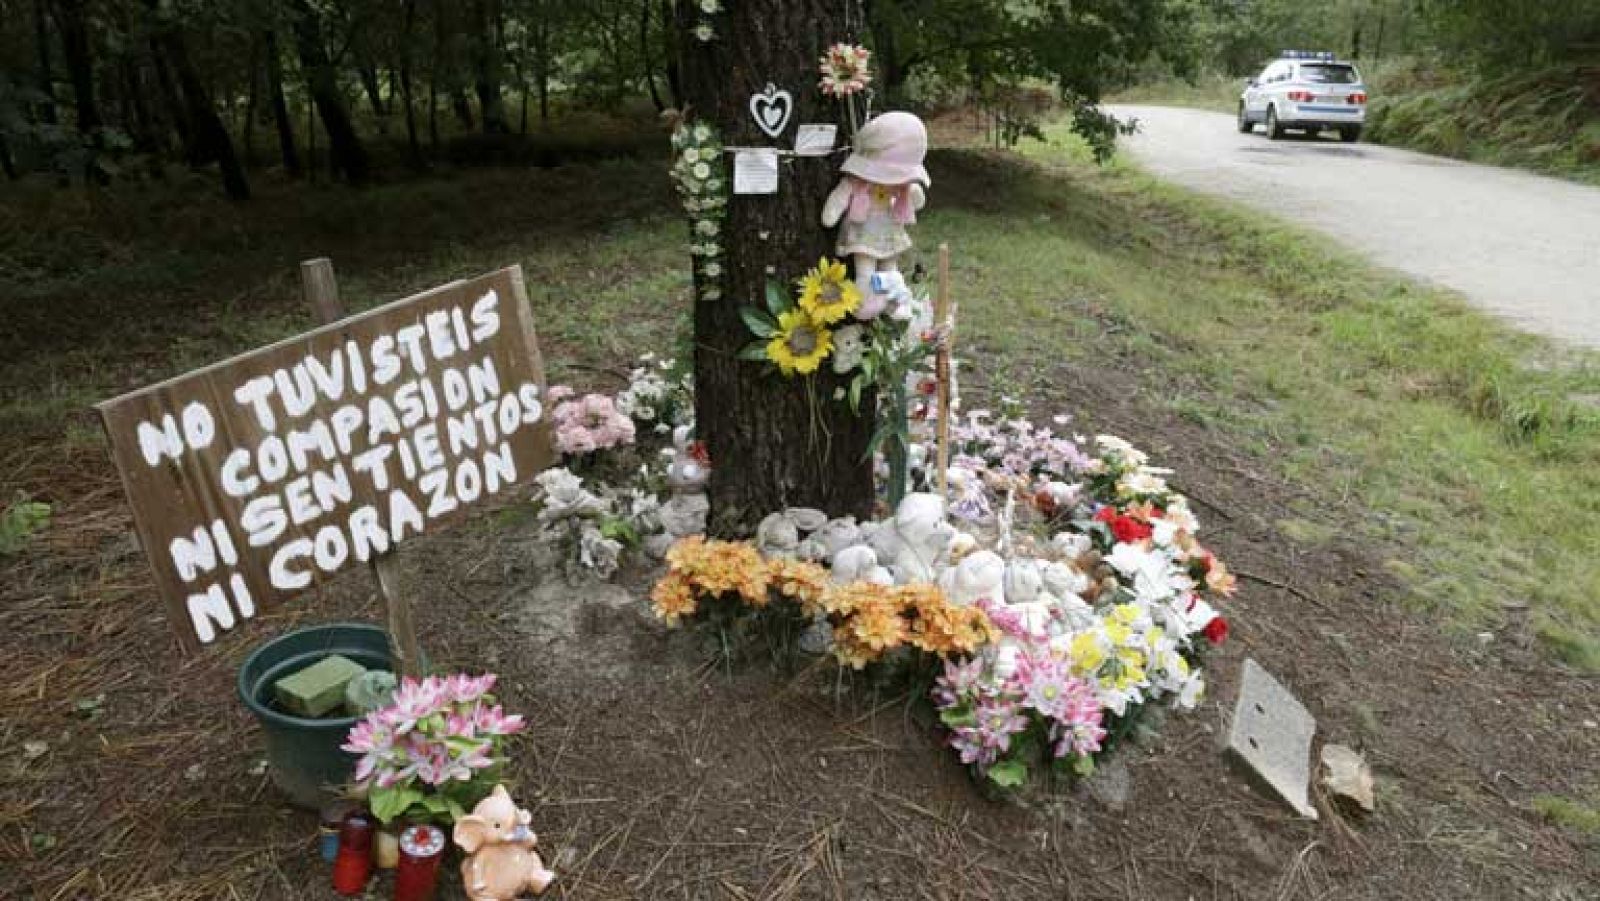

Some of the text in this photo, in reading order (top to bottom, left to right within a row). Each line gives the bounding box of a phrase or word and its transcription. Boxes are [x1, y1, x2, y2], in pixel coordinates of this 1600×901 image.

[137, 290, 500, 466] NO TUVISTEIS
[221, 356, 501, 497] COMPASION
[170, 383, 542, 582] NI SENTIENTOS
[187, 442, 517, 642] NI CORAZON
